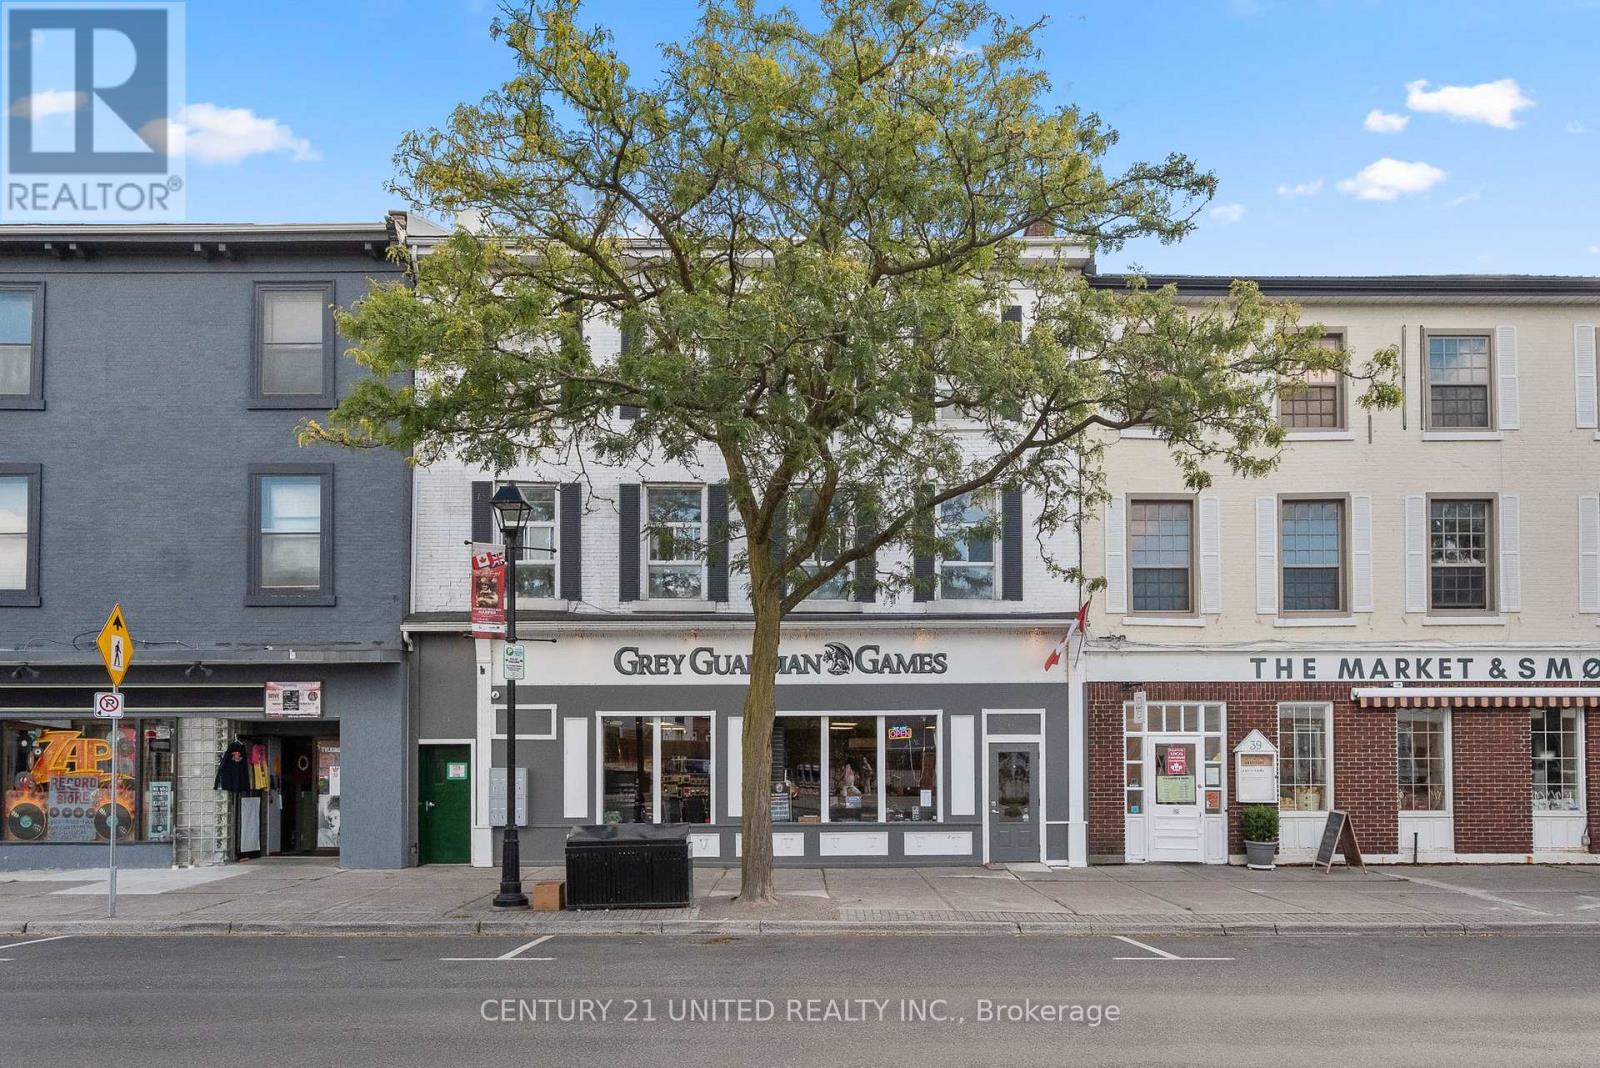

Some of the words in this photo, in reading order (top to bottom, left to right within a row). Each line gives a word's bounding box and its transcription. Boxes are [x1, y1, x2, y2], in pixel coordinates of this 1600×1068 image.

[613, 646, 686, 675] GREY
[689, 646, 821, 675] GUAIAN
[855, 644, 948, 674] GAMES
[1250, 657, 1316, 679] THE
[1338, 657, 1474, 679] MARKET
[890, 730, 911, 738] OPEN
[1249, 740, 1262, 751] 39
[31, 729, 113, 784] ZAP
[50, 777, 97, 791] RECORD
[56, 791, 90, 805] STORE
